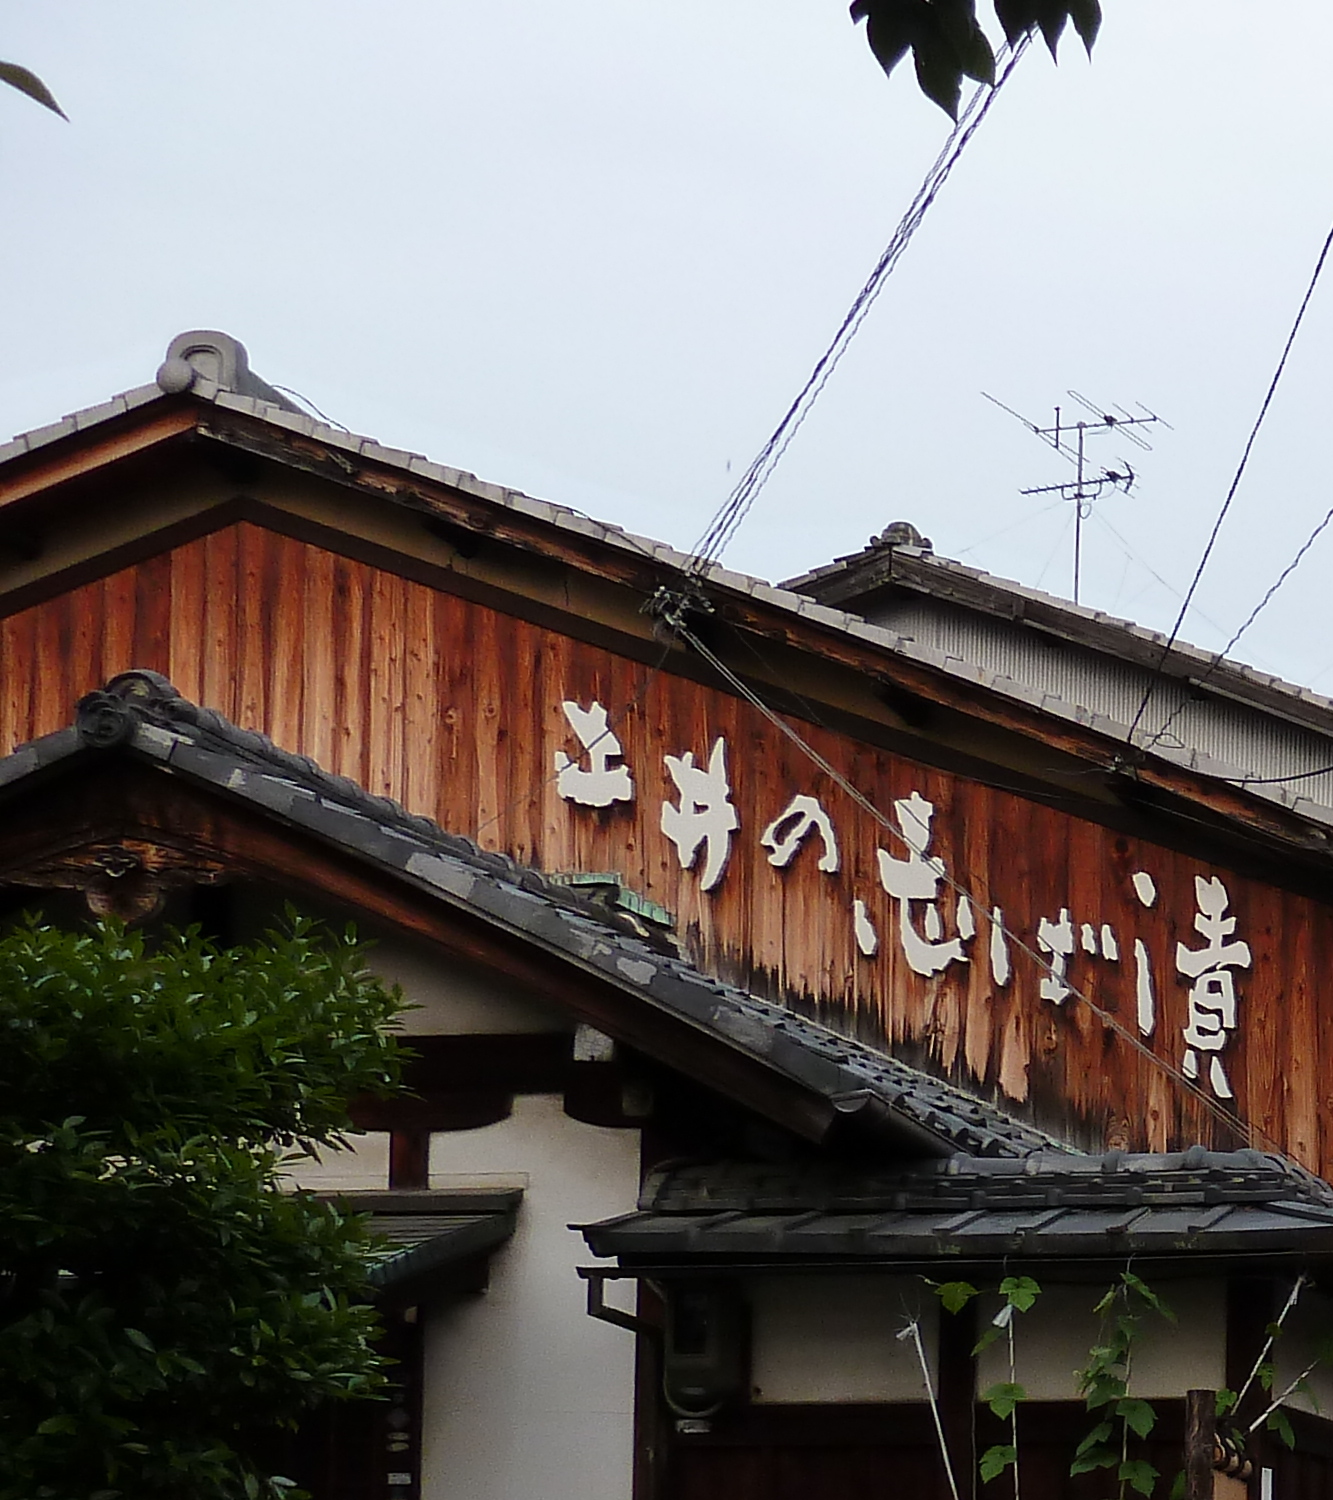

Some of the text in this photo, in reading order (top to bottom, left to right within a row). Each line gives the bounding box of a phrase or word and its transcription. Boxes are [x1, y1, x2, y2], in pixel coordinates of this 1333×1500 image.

[554, 699, 1252, 1099] 土井の志ば漬
